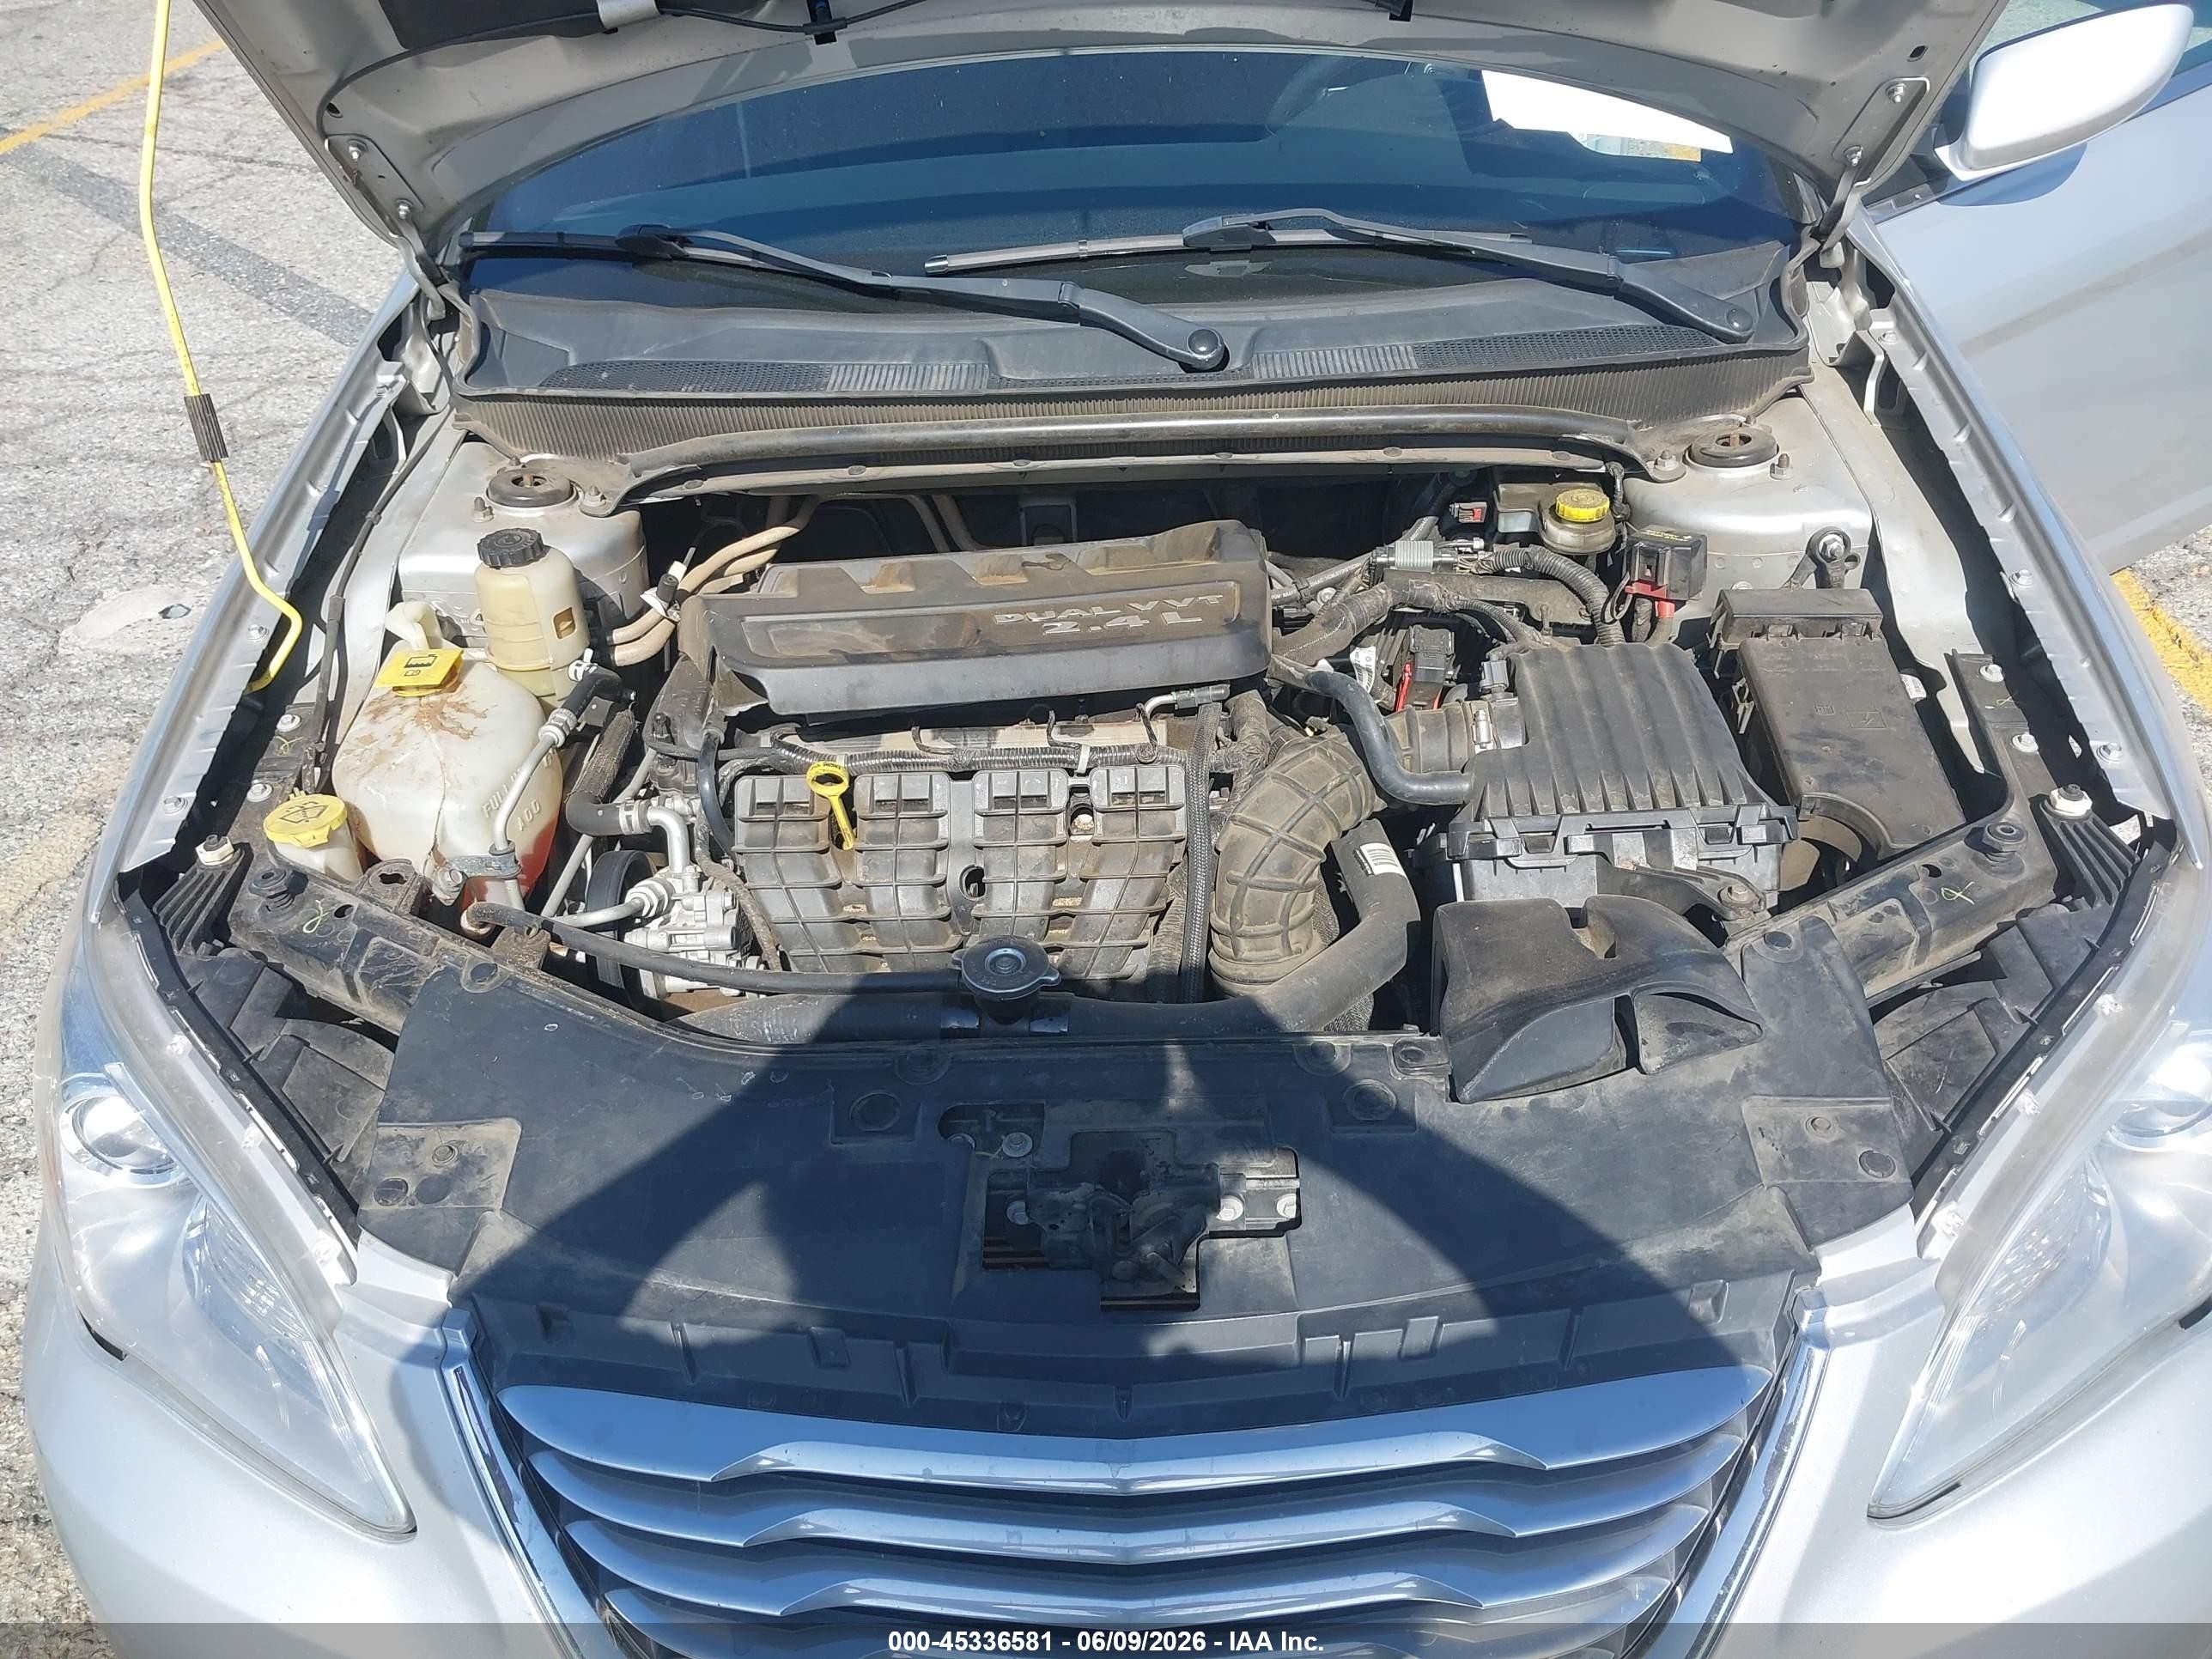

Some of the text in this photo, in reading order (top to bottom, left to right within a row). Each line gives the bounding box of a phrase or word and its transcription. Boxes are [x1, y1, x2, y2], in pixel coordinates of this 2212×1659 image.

[994, 594, 1224, 624] DUAL VVT
[517, 799, 541, 831] ADD
